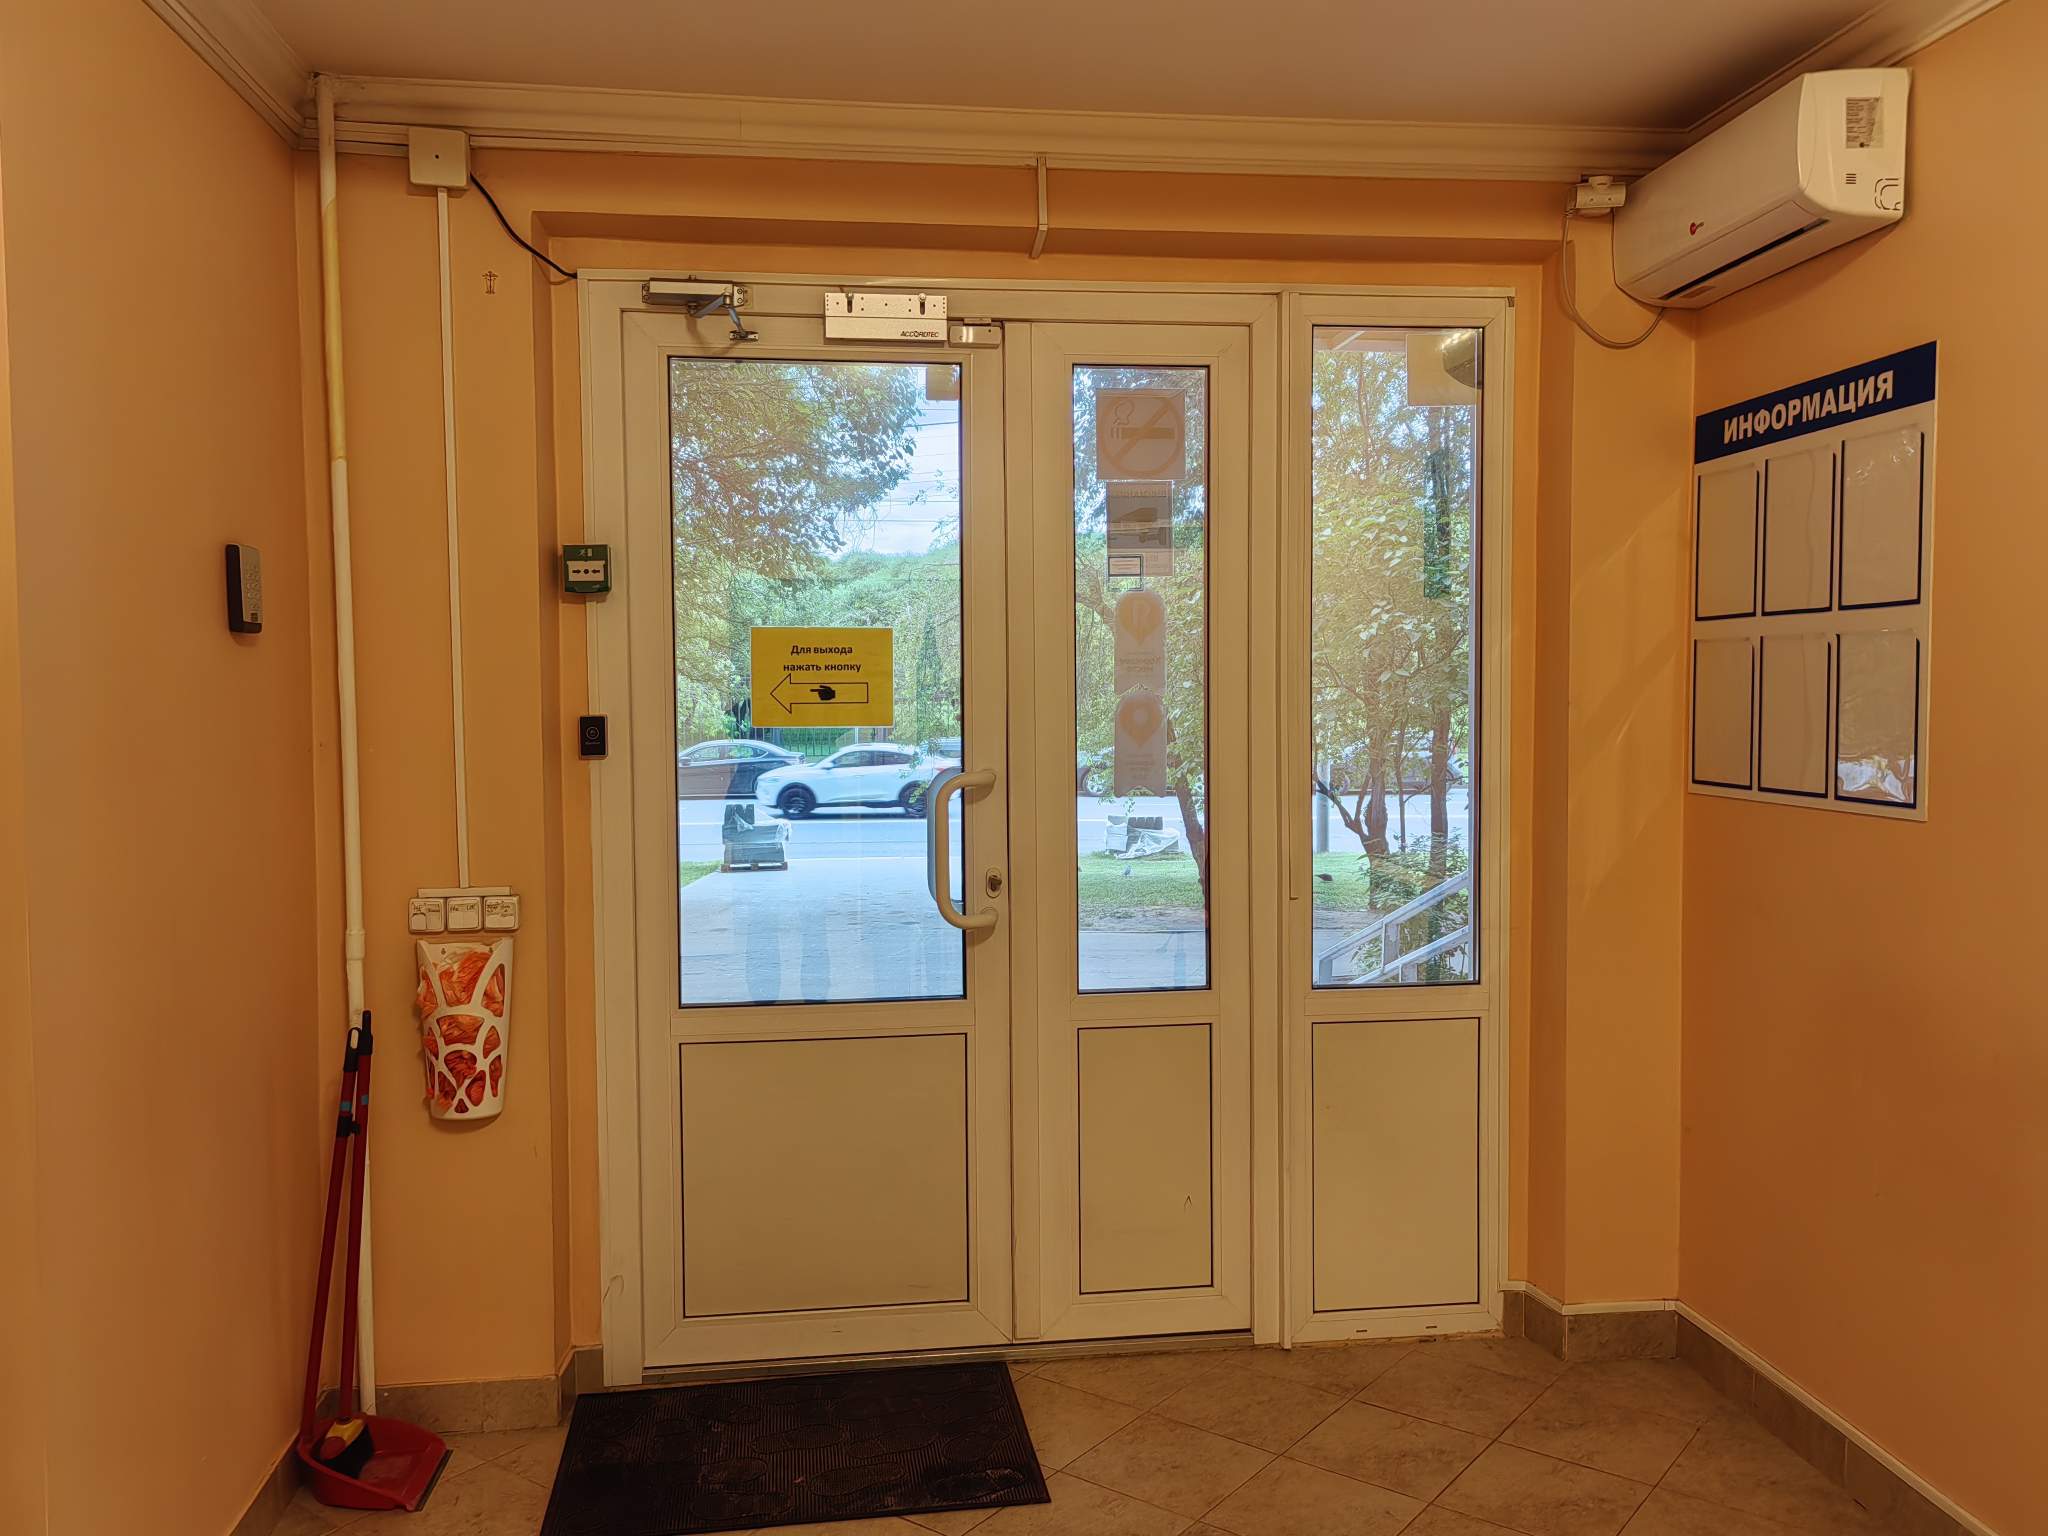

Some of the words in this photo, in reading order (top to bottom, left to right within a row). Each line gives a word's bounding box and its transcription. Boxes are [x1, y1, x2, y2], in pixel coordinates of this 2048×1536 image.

[1723, 370, 1894, 445] ИНФОРМАЦИЯ
[790, 645, 812, 656] Для
[813, 646, 853, 656] выхода
[783, 663, 822, 672] нажать
[824, 663, 861, 673] кнопку
